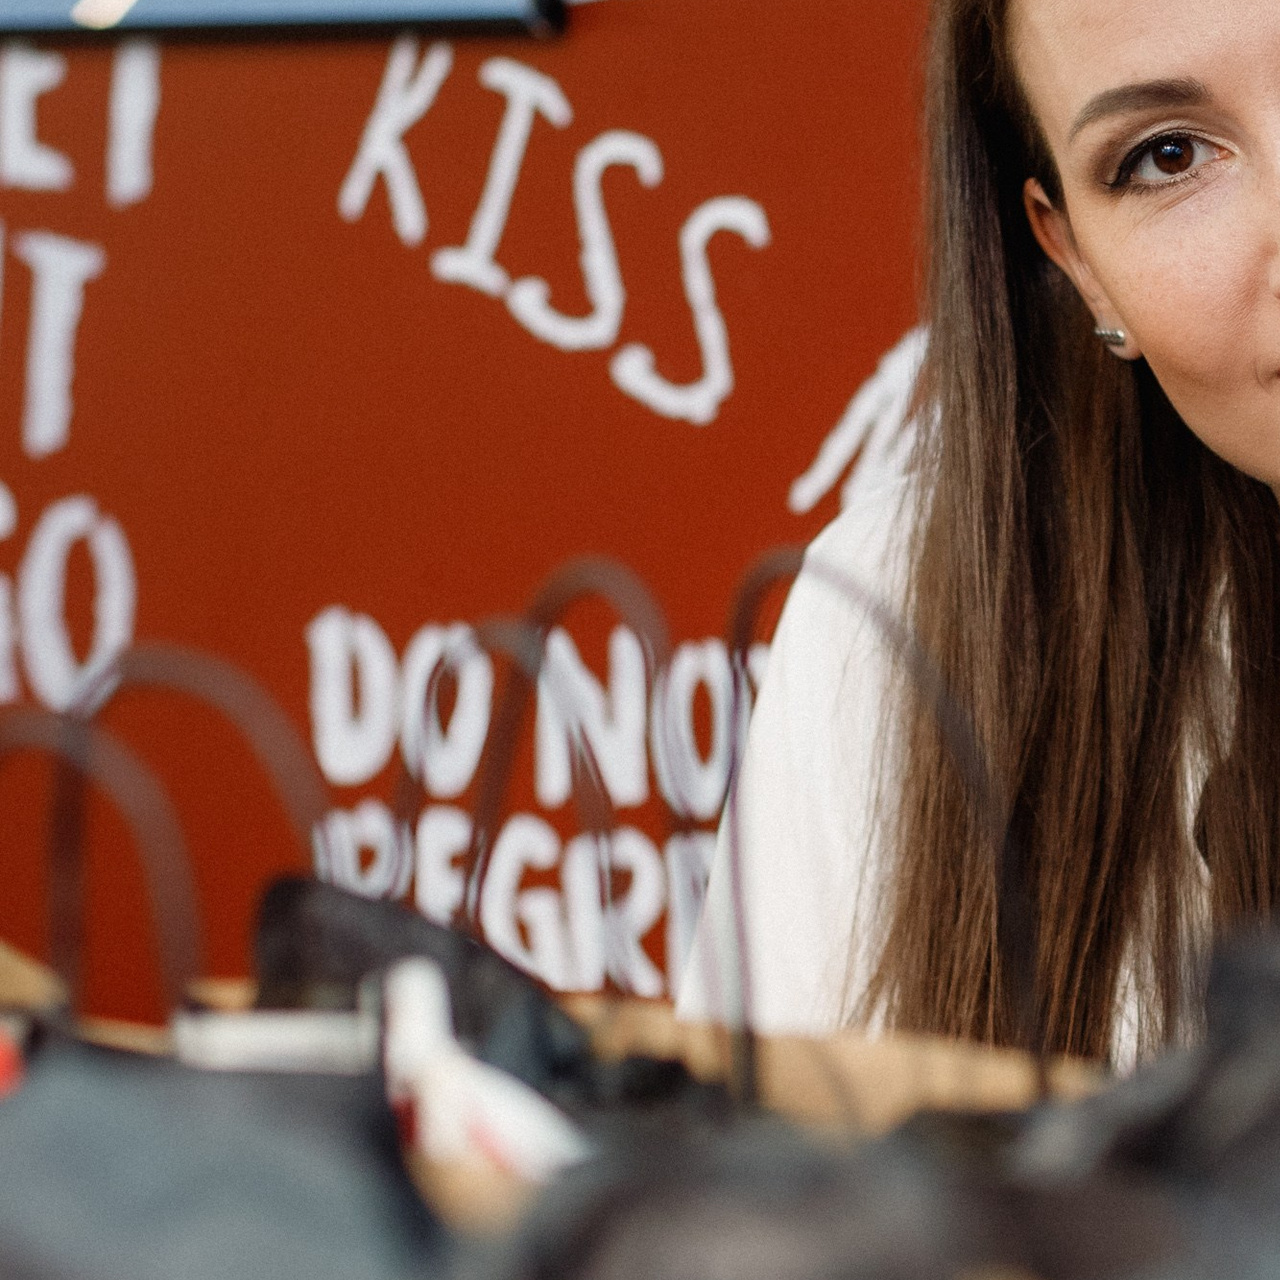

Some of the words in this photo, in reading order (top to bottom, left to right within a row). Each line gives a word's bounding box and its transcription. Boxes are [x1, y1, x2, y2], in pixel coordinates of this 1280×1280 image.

[336, 38, 771, 425] KISS
[304, 604, 495, 800] DO
[534, 624, 775, 821] NO
